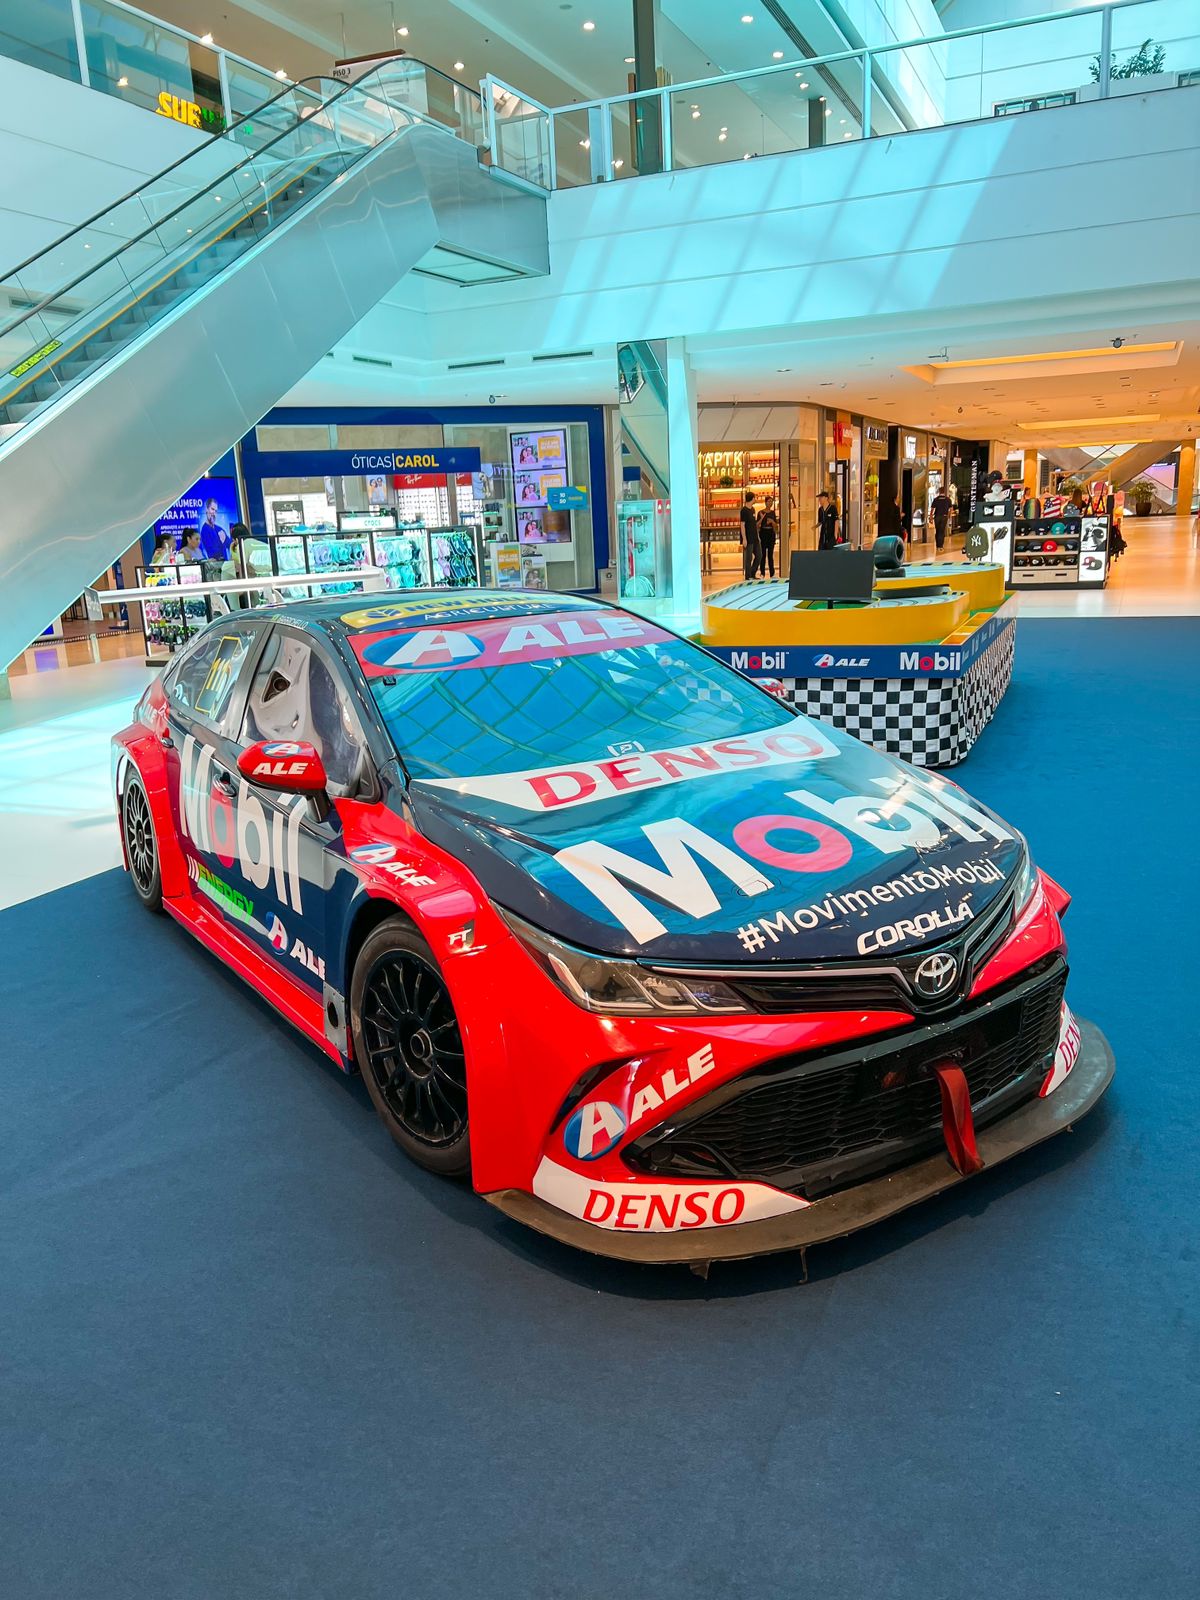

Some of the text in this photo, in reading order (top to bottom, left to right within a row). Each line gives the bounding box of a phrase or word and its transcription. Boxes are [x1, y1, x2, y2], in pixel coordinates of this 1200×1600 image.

[351, 453, 439, 469] ÓTICAS CAROL
[703, 451, 743, 477] APTK SPIRITS
[180, 510, 186, 520] A
[424, 602, 555, 621] AGRICULTURE
[498, 616, 646, 653] ALE
[731, 651, 787, 670] Mobil
[835, 657, 871, 668] ALE
[900, 652, 961, 671] Mobil
[251, 762, 309, 776] ALE
[523, 733, 826, 808] DENSO
[552, 774, 1015, 945] Mobil
[376, 861, 437, 887] ALE
[198, 862, 255, 924] ENERGY
[735, 857, 1007, 955] #MovimentoMobil
[855, 901, 975, 956] COROLLA
[629, 1042, 716, 1125] ALE
[581, 1188, 746, 1229] DENSO
